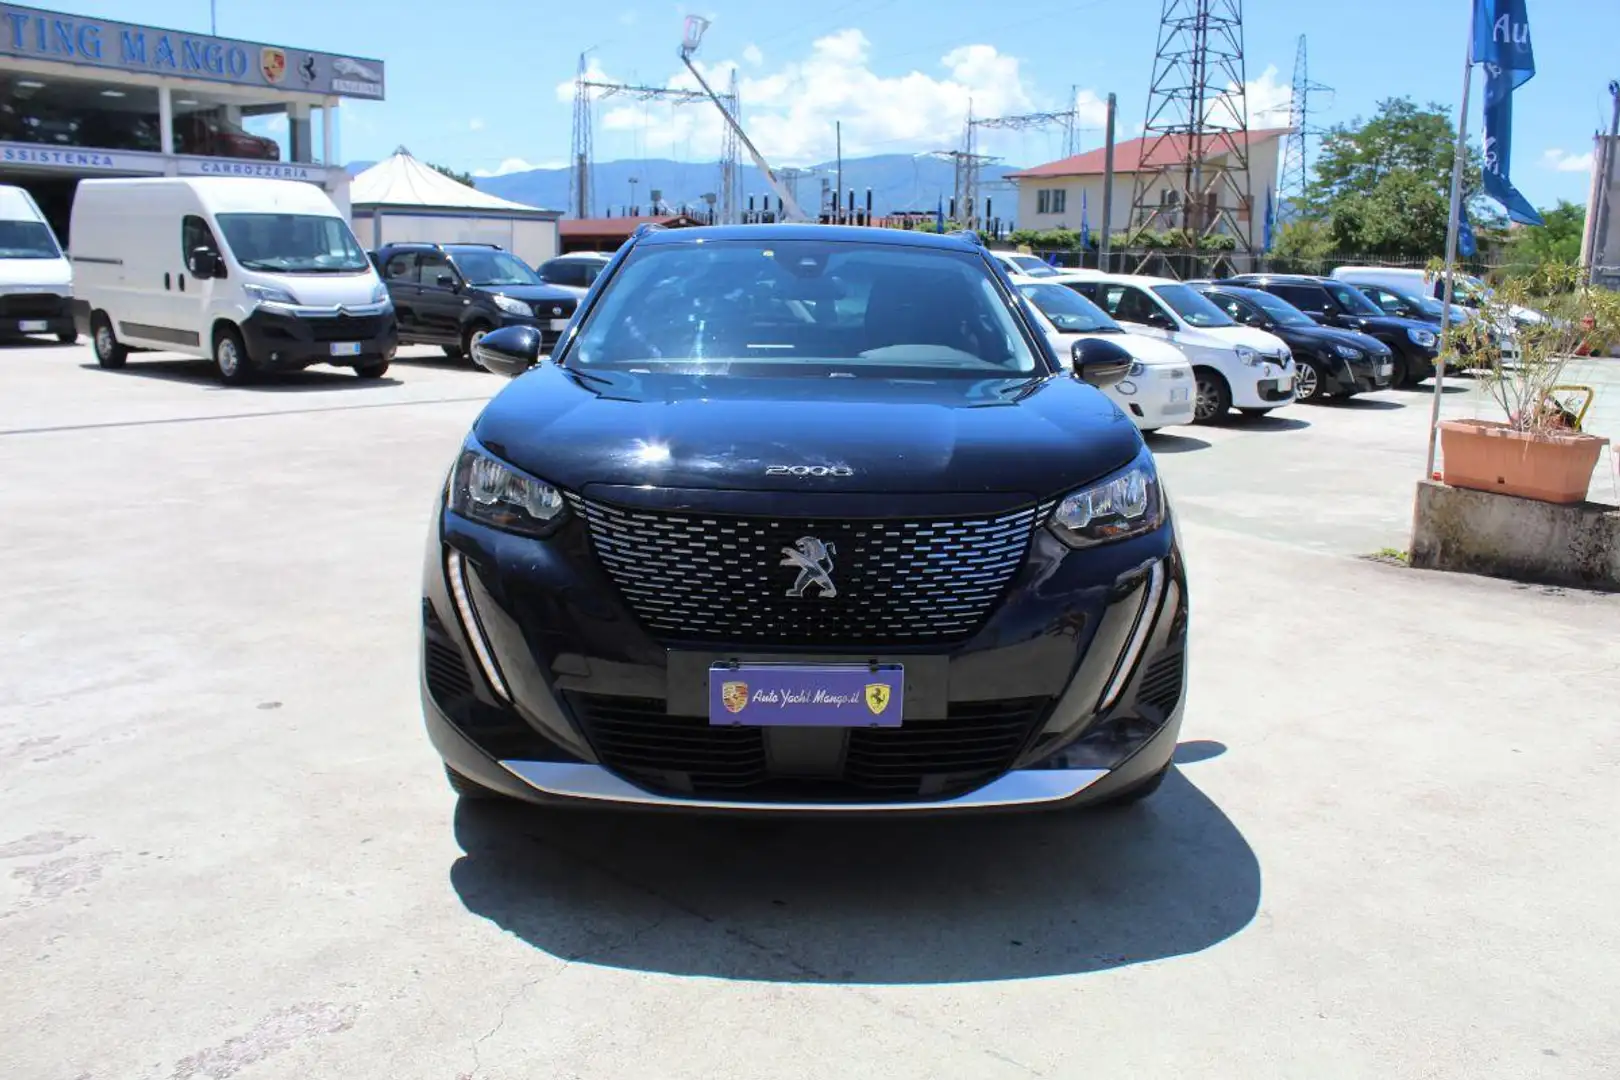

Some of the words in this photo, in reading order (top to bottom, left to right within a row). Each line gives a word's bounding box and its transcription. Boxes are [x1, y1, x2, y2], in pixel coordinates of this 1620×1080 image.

[8, 12, 104, 60] TING
[118, 28, 249, 78] MANGO
[201, 163, 308, 179] CARROZZERIA
[765, 465, 854, 476] 2008
[752, 688, 779, 703] Auto
[780, 688, 812, 708] Yacht
